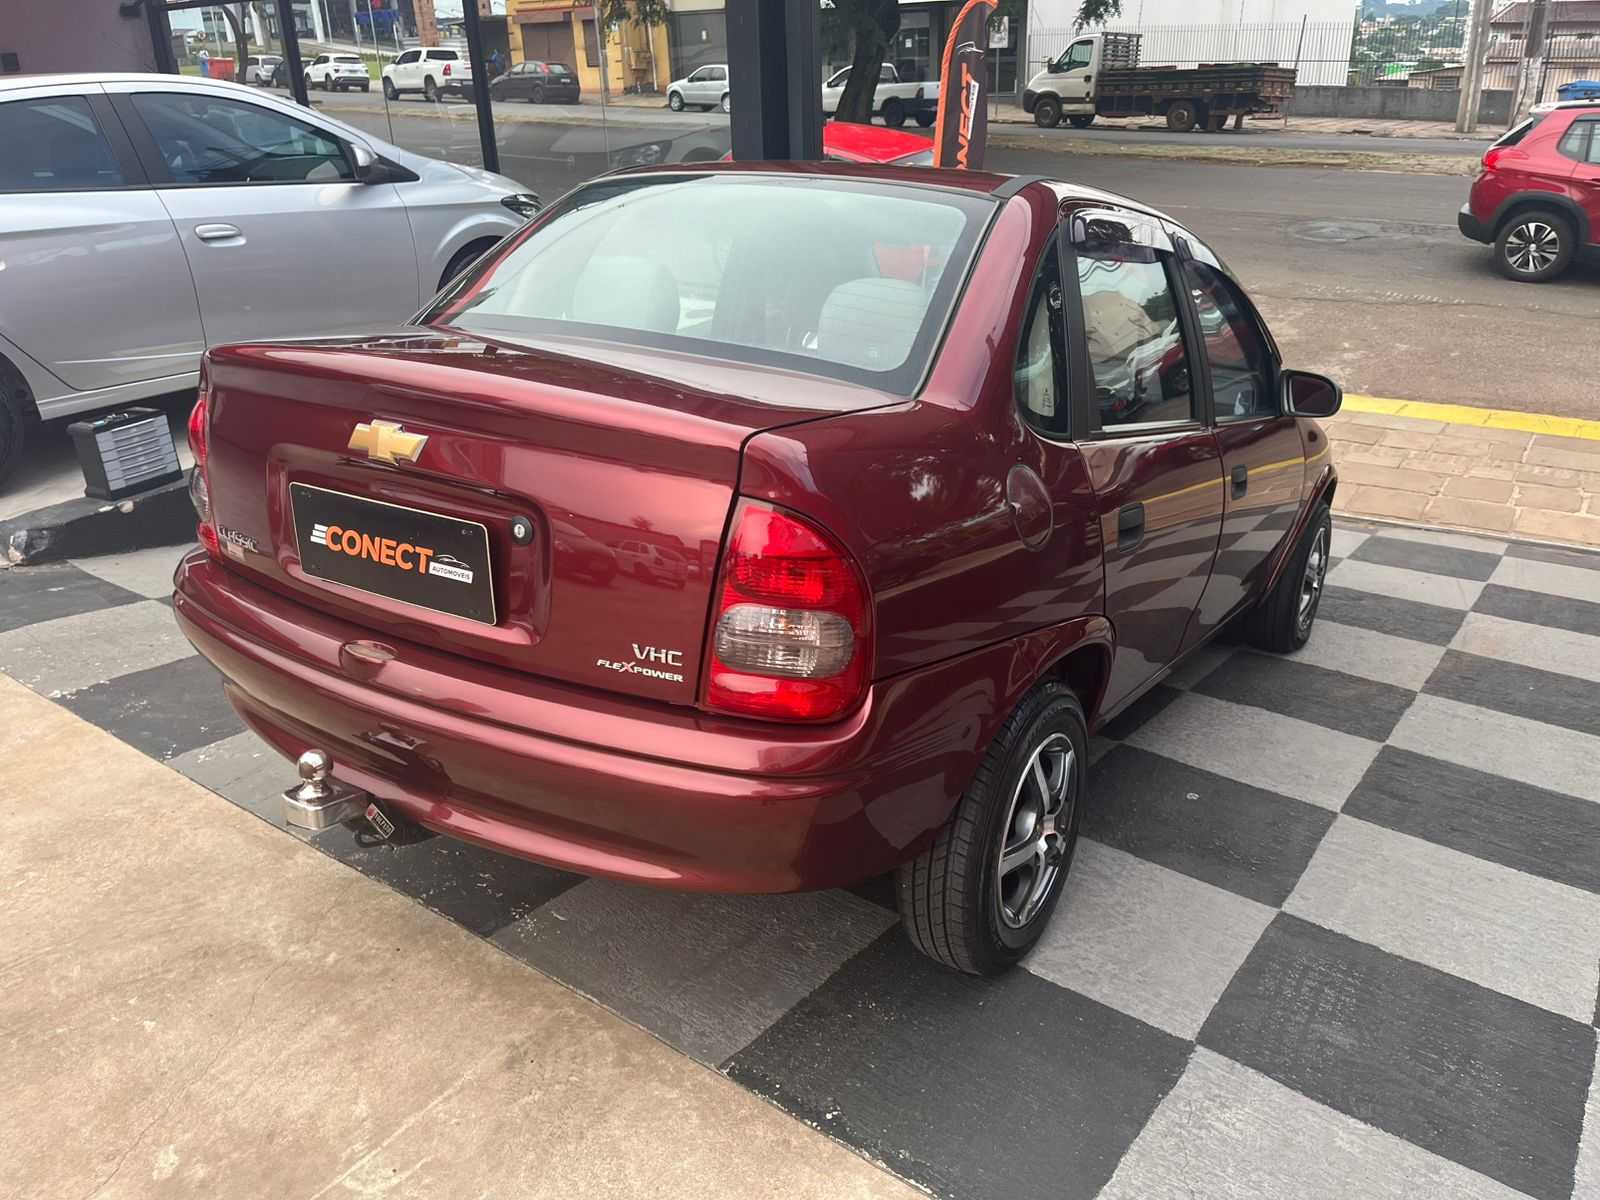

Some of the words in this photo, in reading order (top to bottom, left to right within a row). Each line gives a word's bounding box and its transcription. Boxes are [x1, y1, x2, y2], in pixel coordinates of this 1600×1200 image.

[956, 63, 974, 169] NECT
[325, 525, 433, 575] CONECT
[631, 643, 683, 667] VHC
